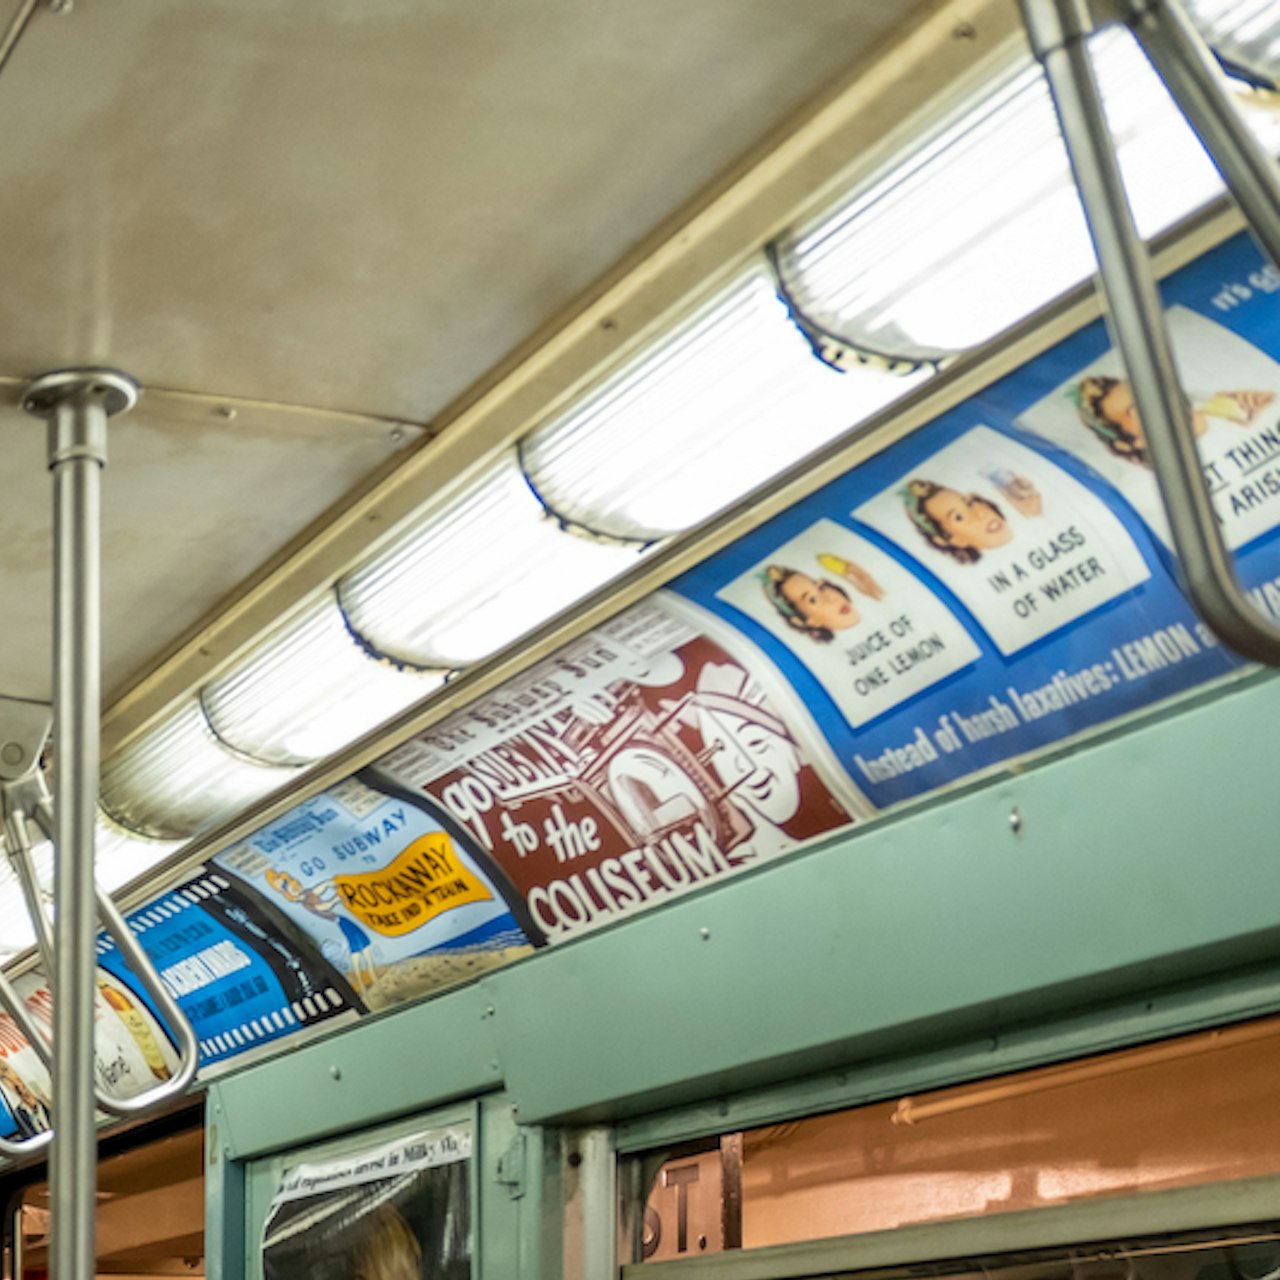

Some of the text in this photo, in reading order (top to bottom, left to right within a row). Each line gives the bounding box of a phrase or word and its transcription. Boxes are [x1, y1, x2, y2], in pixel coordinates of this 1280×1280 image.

[989, 526, 1087, 594] IN A GLASS
[1012, 557, 1107, 620] OF WATER
[847, 613, 915, 667] JUICE OF
[853, 633, 947, 698] ONE LEMON
[854, 620, 1194, 786] Instead of harsh laxatives: LEMON
[299, 854, 327, 879] GO
[331, 808, 410, 861] SUBWAY
[442, 778, 495, 852] go
[500, 803, 601, 863] to the
[339, 841, 454, 909] ROCKAWAY
[365, 911, 403, 928] TAKE
[400, 901, 422, 922] IND
[429, 877, 470, 901] TRAIN
[526, 824, 733, 939] COLISEUM
